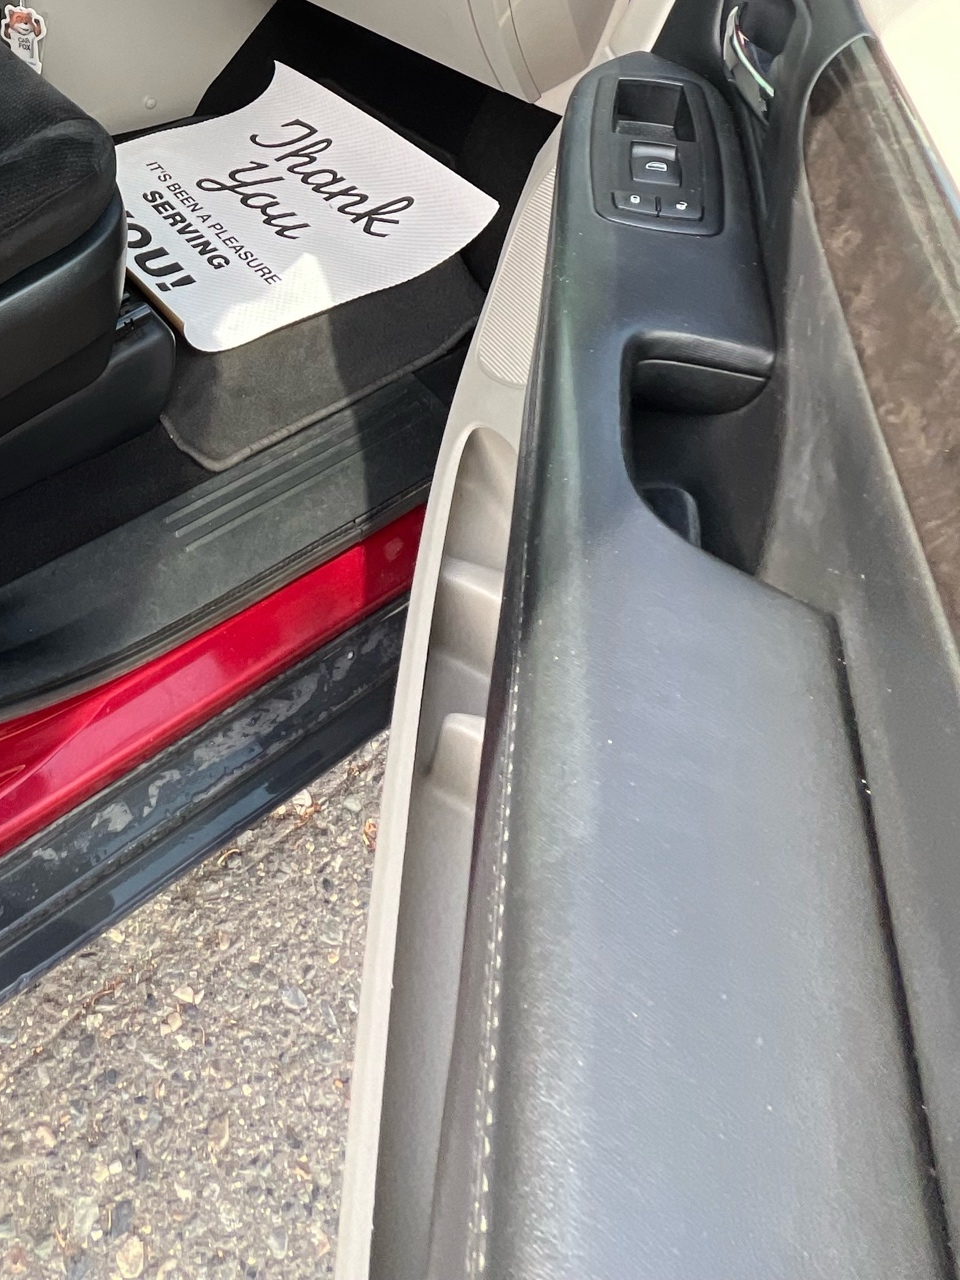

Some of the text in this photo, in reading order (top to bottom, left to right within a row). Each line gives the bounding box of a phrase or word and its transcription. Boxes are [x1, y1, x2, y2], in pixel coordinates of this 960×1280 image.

[196, 161, 311, 239] You
[250, 118, 415, 238] Thank
[126, 210, 197, 292] OU!
[142, 190, 230, 270] SERVING
[146, 161, 282, 285] IT'S BEEN A PLEASURE
